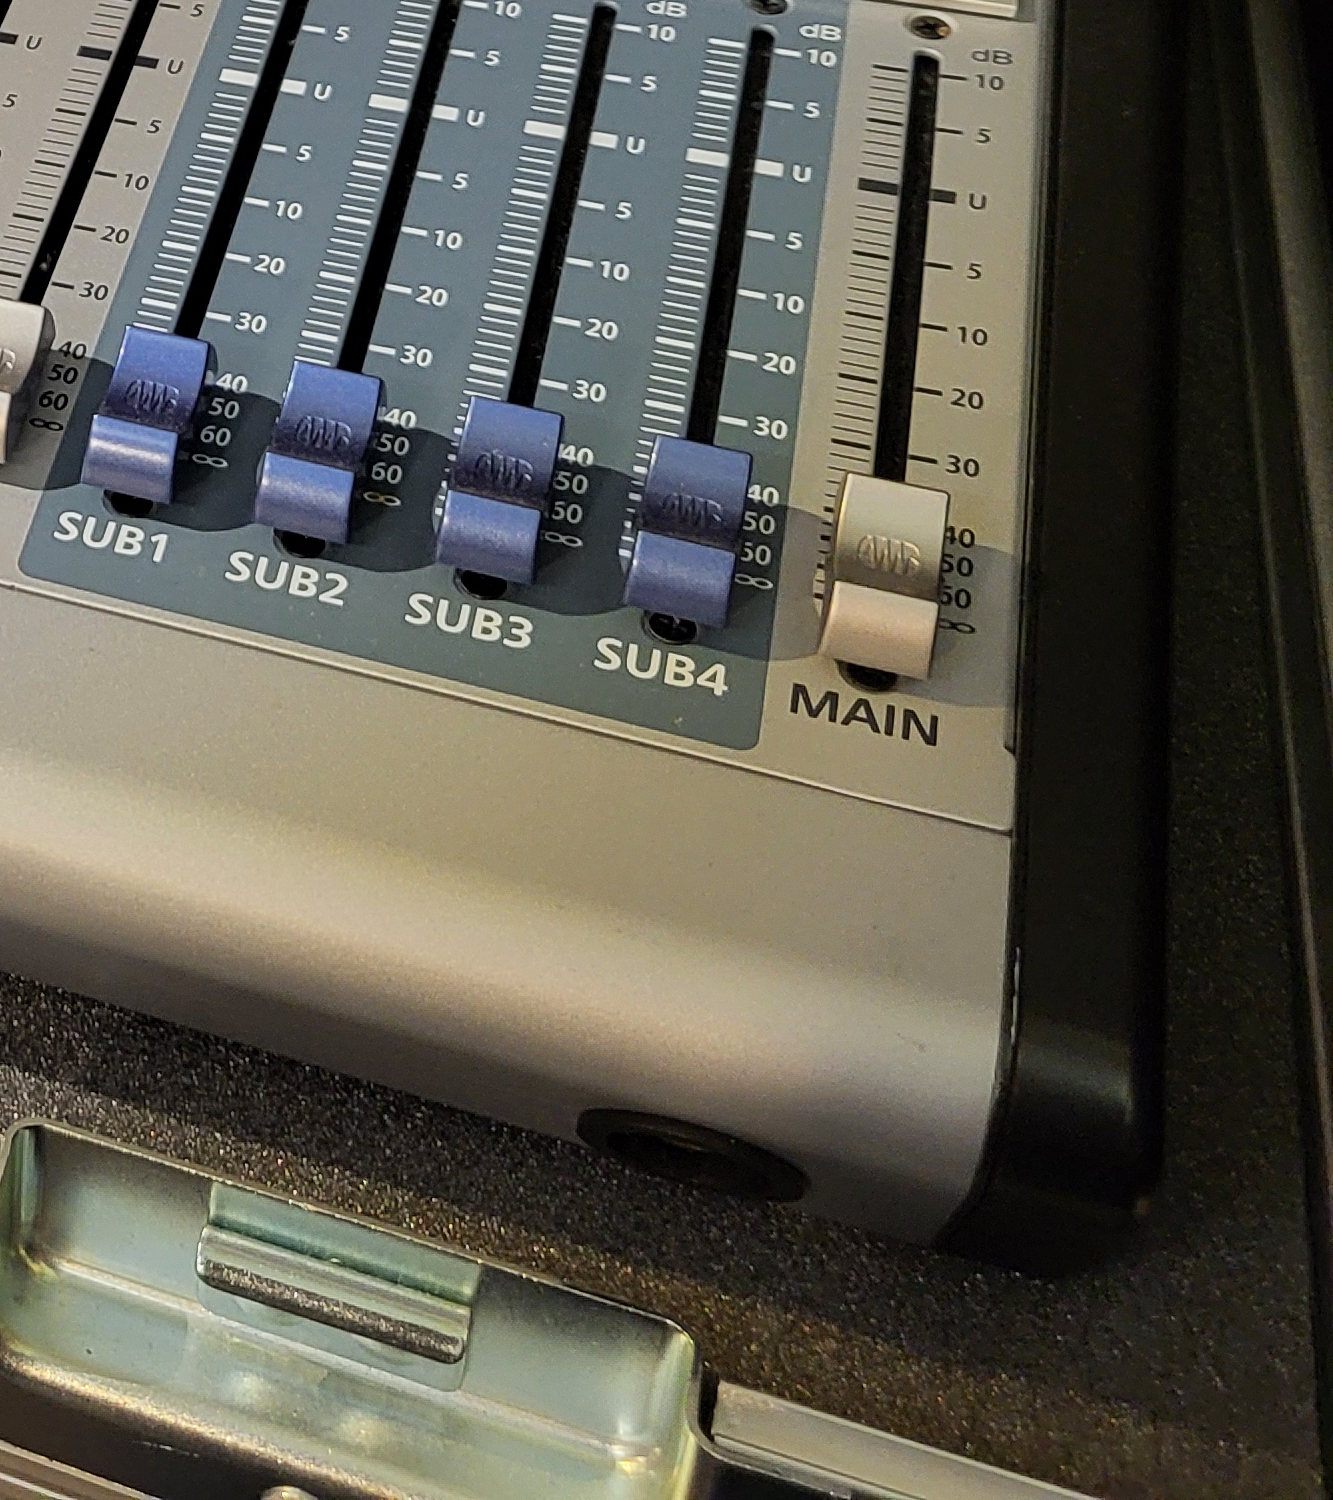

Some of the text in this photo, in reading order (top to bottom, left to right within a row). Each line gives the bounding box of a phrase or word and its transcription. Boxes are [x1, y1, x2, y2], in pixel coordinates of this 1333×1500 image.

[971, 47, 1013, 66] dB
[975, 73, 1004, 93] 10
[976, 125, 992, 144] 5
[968, 192, 986, 211] U
[966, 261, 983, 280] 5
[956, 325, 989, 346] 10
[950, 388, 985, 410] 20
[944, 454, 981, 478] 30
[53, 511, 168, 563] SUB1
[224, 551, 349, 607] SUB2
[404, 593, 534, 649] SUB3
[593, 637, 729, 697] SUB4
[789, 682, 939, 747] MAIN
